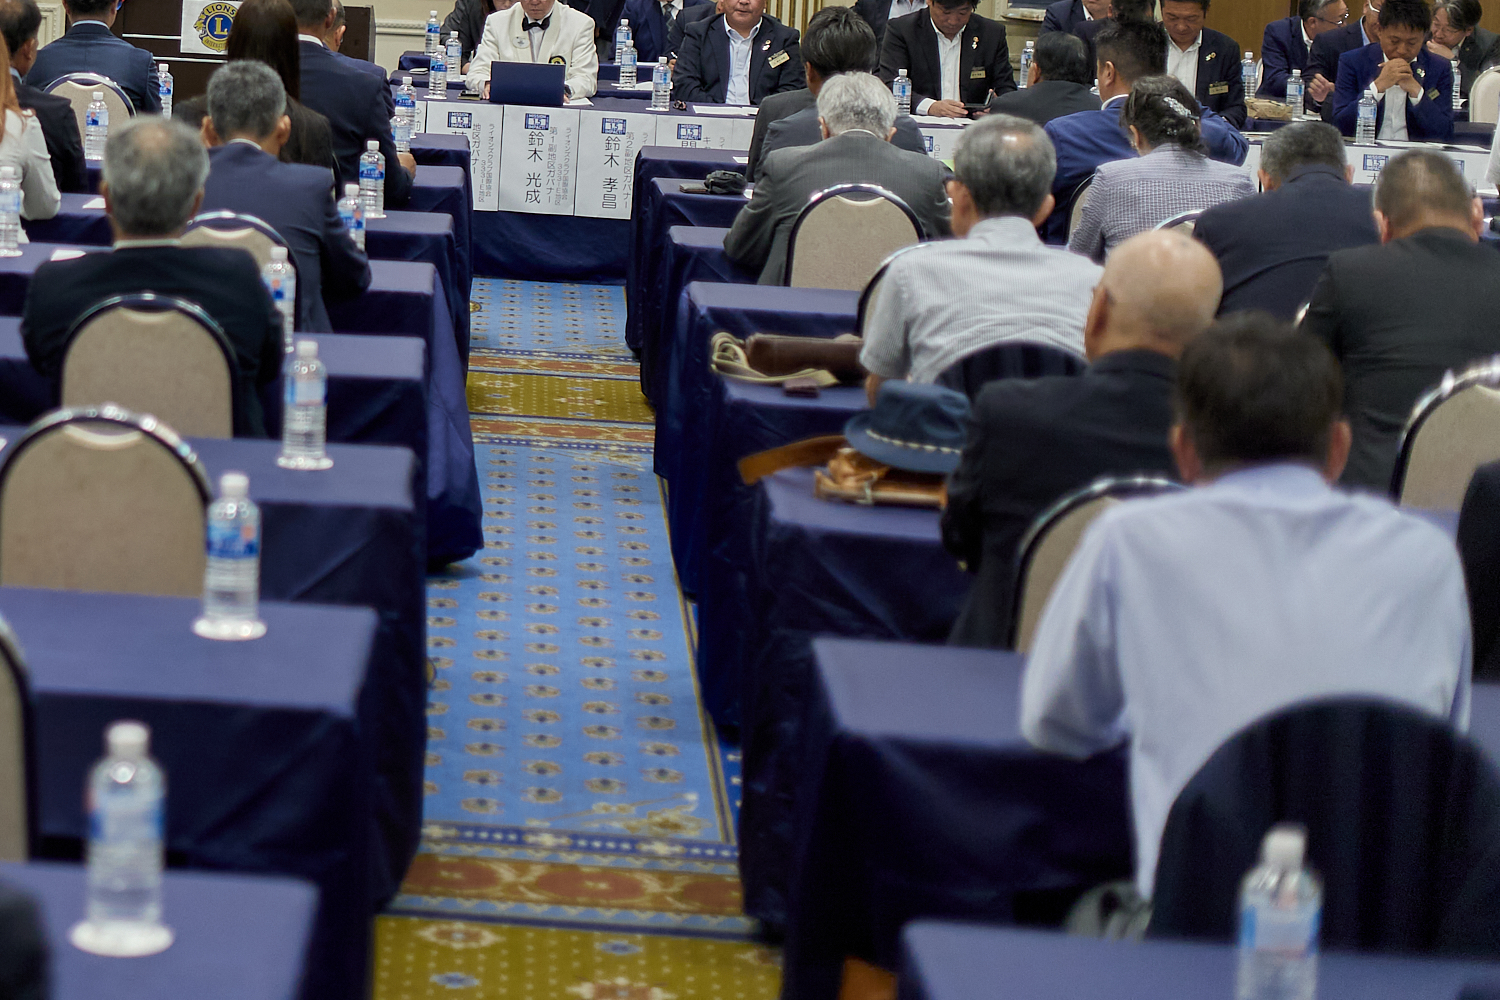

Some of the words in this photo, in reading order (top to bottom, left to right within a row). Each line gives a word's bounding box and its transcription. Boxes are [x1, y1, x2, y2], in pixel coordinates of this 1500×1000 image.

[206, 4, 236, 16] LIONS
[214, 17, 228, 35] L
[527, 131, 545, 162] 鈴木
[604, 136, 621, 167] 鈴木
